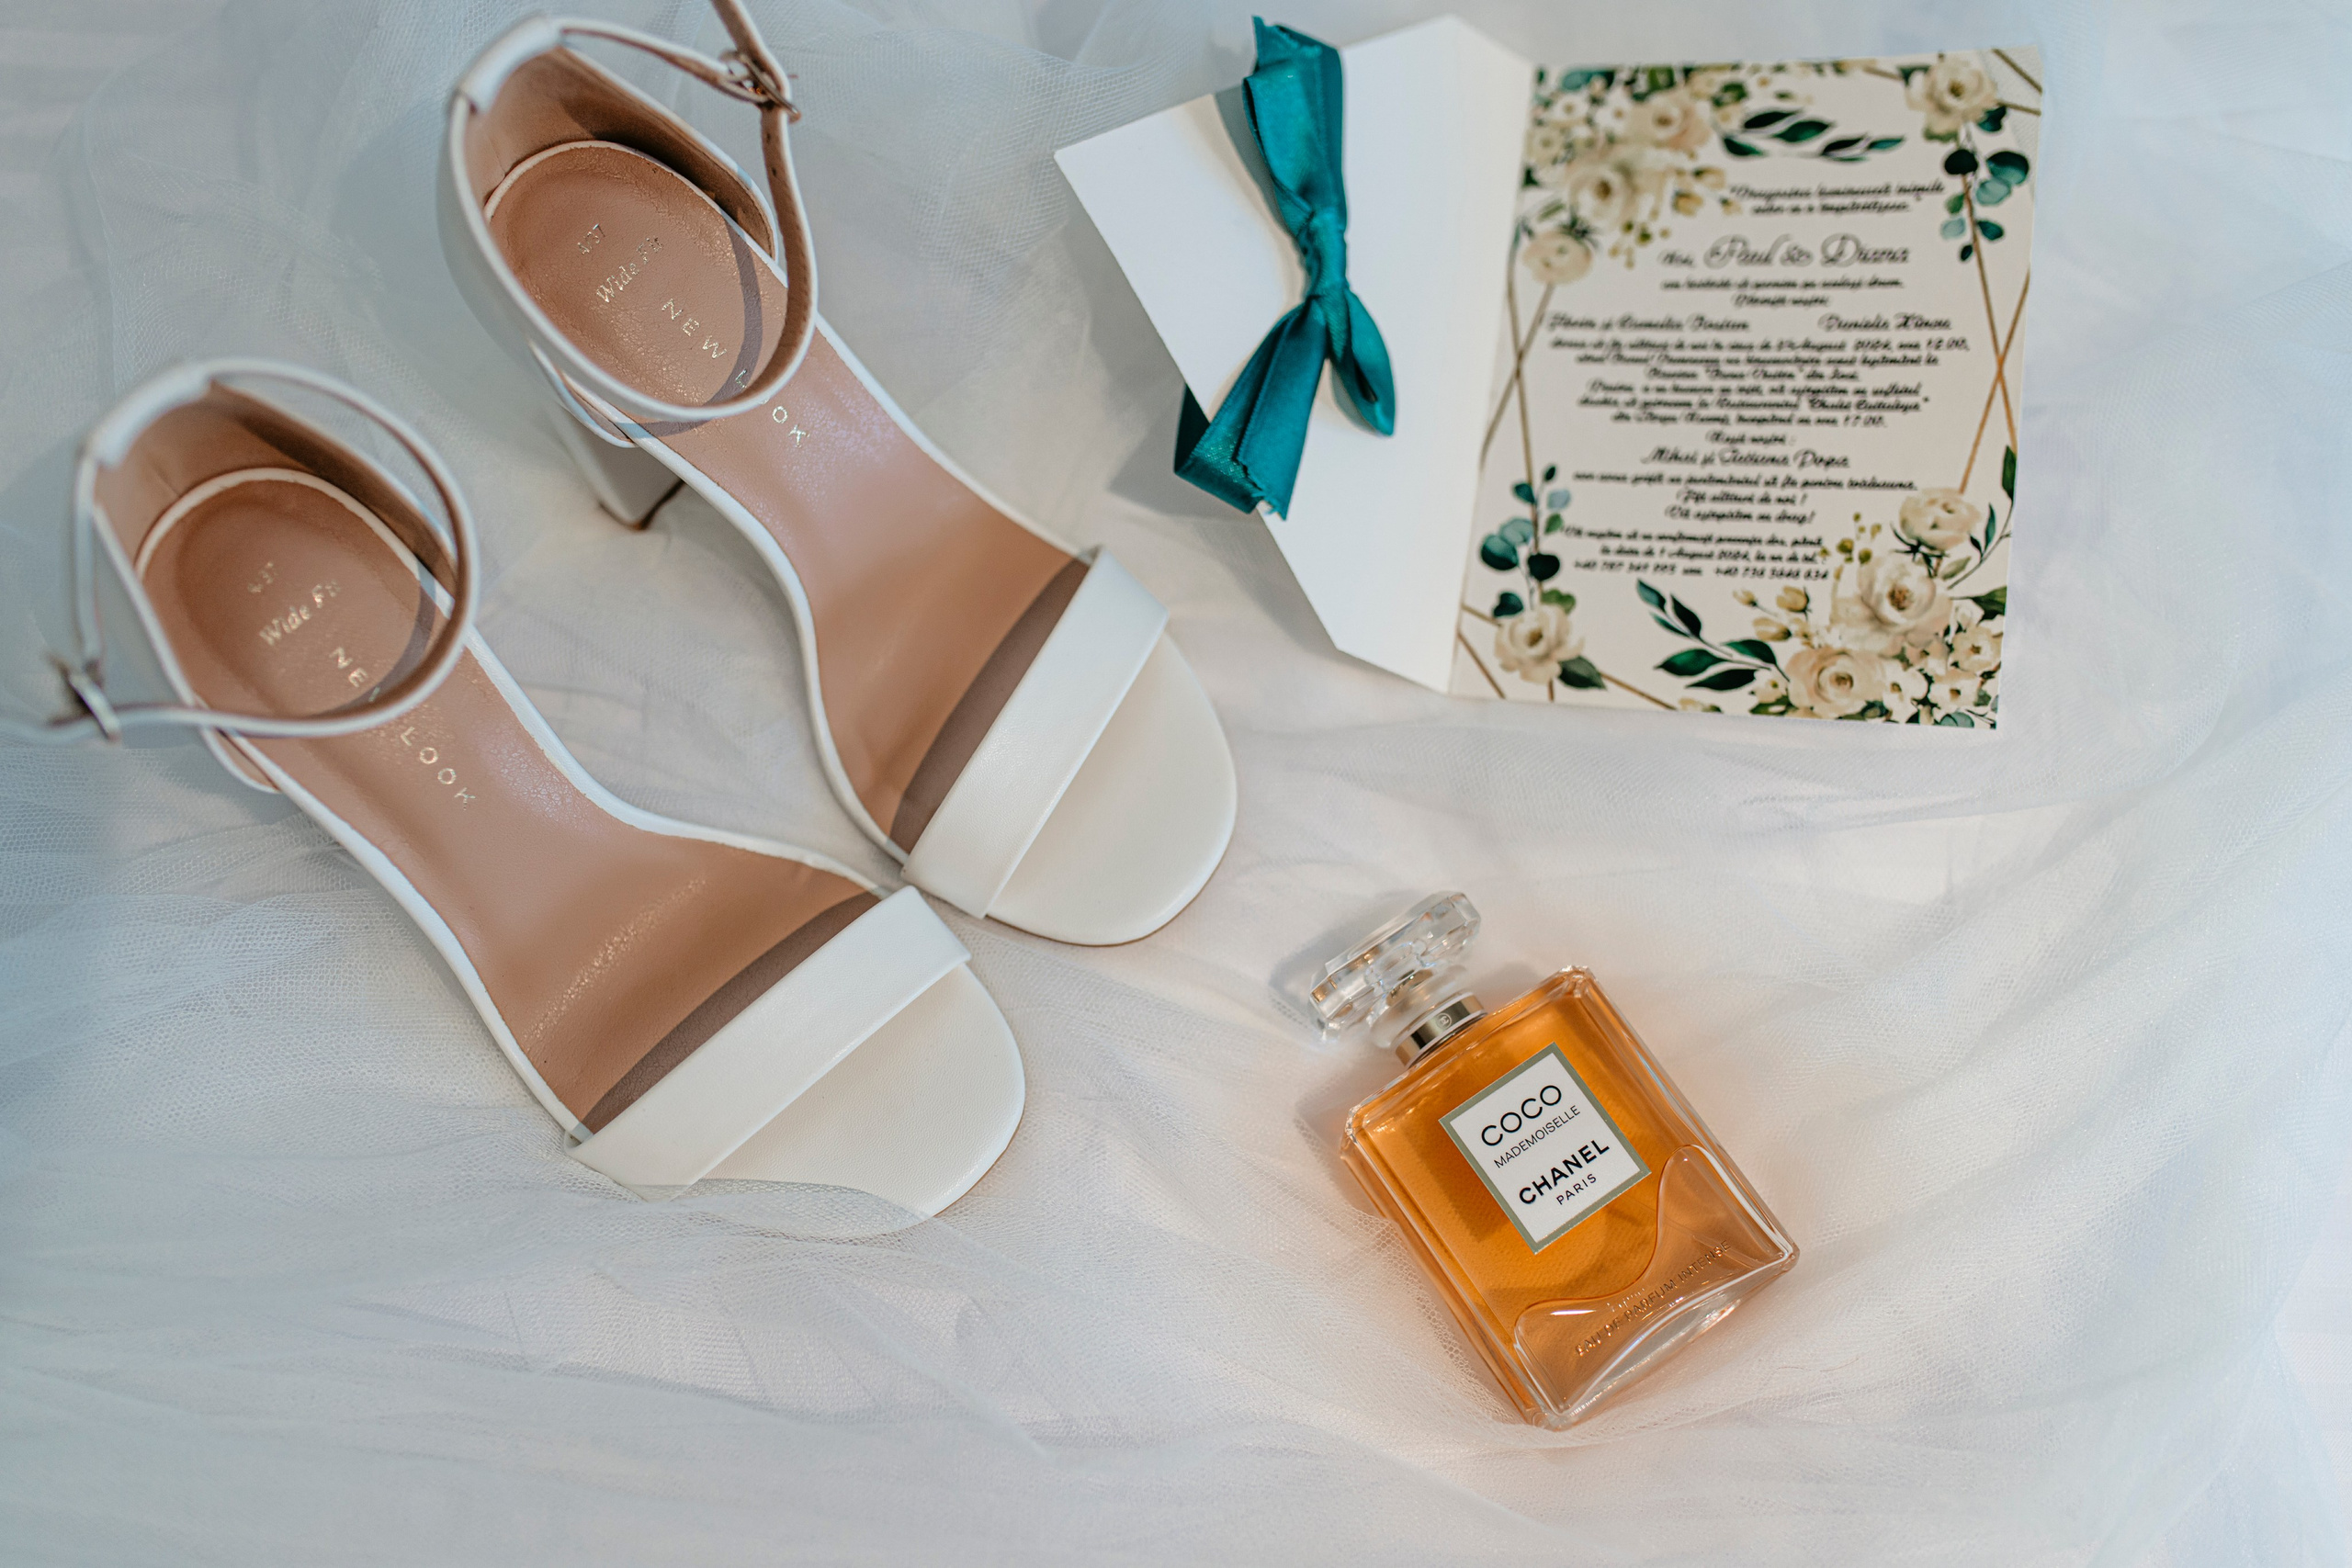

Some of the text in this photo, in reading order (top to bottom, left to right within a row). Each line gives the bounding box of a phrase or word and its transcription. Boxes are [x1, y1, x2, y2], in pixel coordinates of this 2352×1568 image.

[1702, 233, 1791, 269] Paul
[1819, 232, 1911, 268] Diana
[595, 263, 639, 303] Wide
[662, 298, 811, 448] NEW LOK
[259, 605, 311, 646] Wide
[400, 726, 476, 810] LOOK
[1481, 1085, 1562, 1146] COCO
[1493, 1105, 1581, 1168] MADEMOISELLE
[1519, 1140, 1610, 1204] CHANEL
[1555, 1173, 1597, 1205] PARIS
[1575, 1335, 1602, 1357] EAU
[1623, 1278, 1679, 1322] PARFUM
[1677, 1240, 1732, 1284] INTENSE
